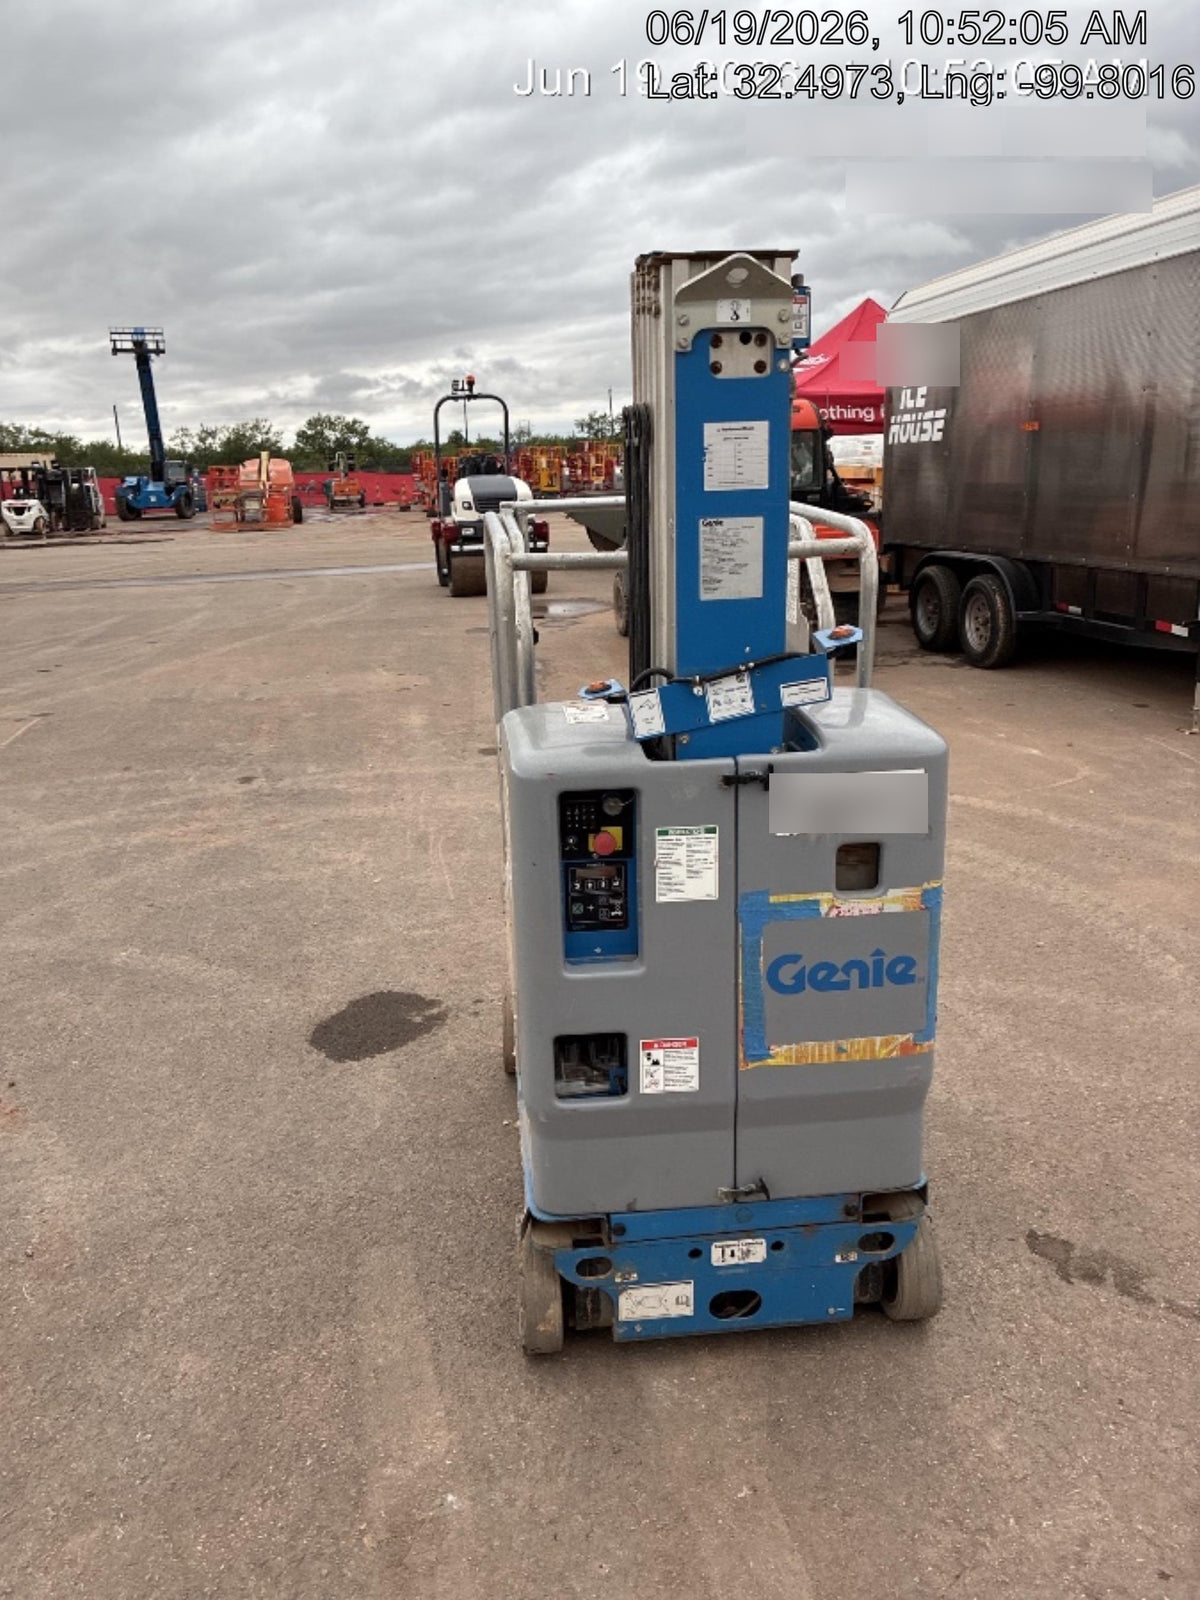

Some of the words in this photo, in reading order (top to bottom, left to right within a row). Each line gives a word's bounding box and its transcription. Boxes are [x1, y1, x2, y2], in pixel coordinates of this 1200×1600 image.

[818, 405, 875, 422] othing
[888, 408, 947, 446] HOUSE
[766, 948, 917, 996] Genie
